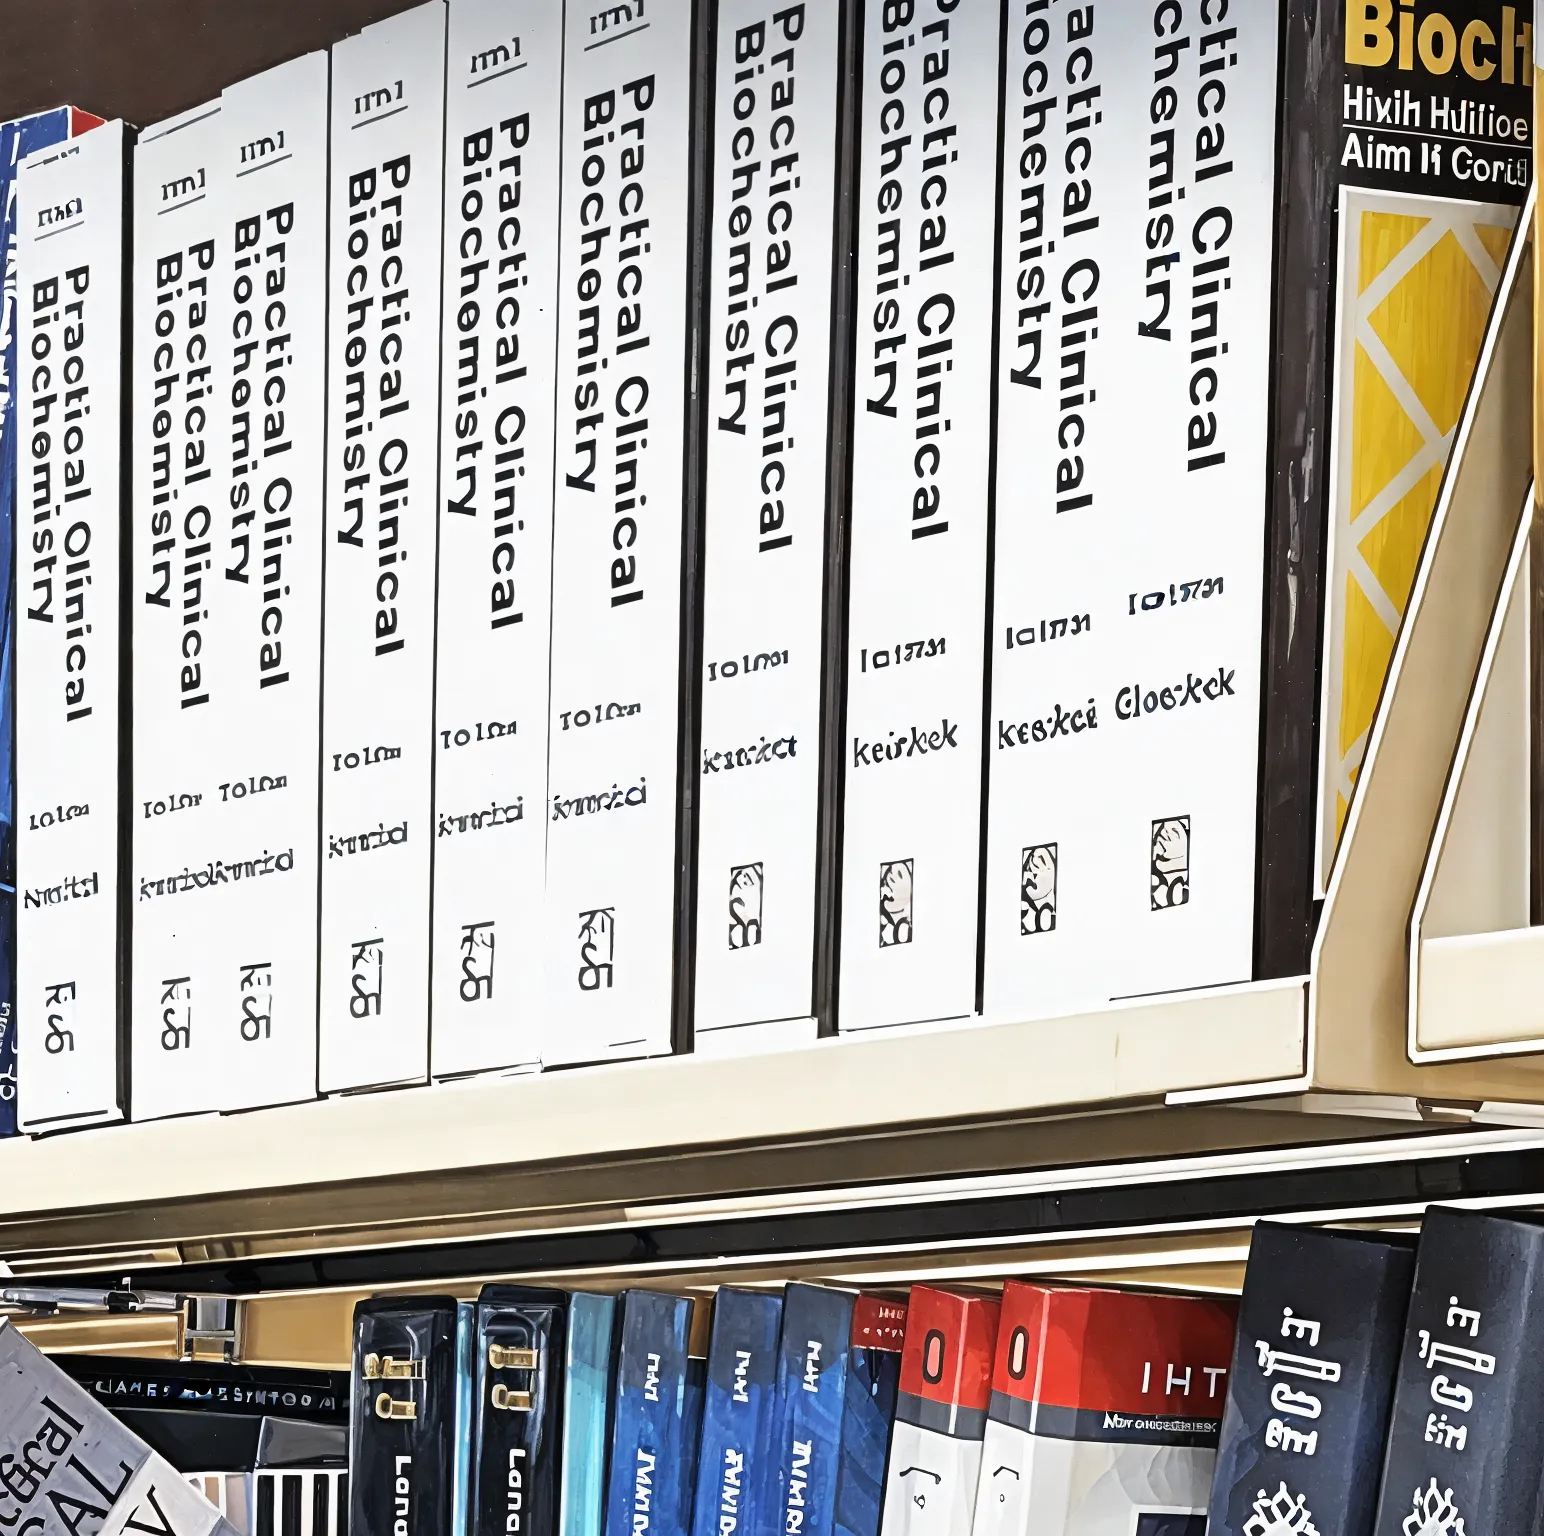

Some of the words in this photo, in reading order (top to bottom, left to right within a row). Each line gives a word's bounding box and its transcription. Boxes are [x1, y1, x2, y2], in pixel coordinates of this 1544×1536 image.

[493, 112, 530, 383] Practical
[614, 75, 656, 355] Practical
[717, 21, 767, 436] Biochemistry
[765, 3, 805, 294] Practical
[184, 238, 216, 485] Practical
[225, 214, 261, 584] Biochemistry
[262, 202, 295, 458] Practical
[337, 168, 377, 547] Biochemistry
[379, 154, 411, 417] Practical
[447, 128, 494, 517] Biochemistry
[565, 90, 616, 492] Biochemistry
[911, 293, 956, 540] Clinical
[1055, 257, 1101, 515] Clinical
[1186, 205, 1233, 472] Clinical
[145, 251, 183, 608] Biochemistry
[373, 437, 409, 656] Clinical
[490, 404, 526, 630] Clinical
[609, 375, 650, 607] Clinical
[758, 314, 799, 553] Clinical
[181, 505, 212, 709] Clinical
[259, 476, 294, 689] Clinical
